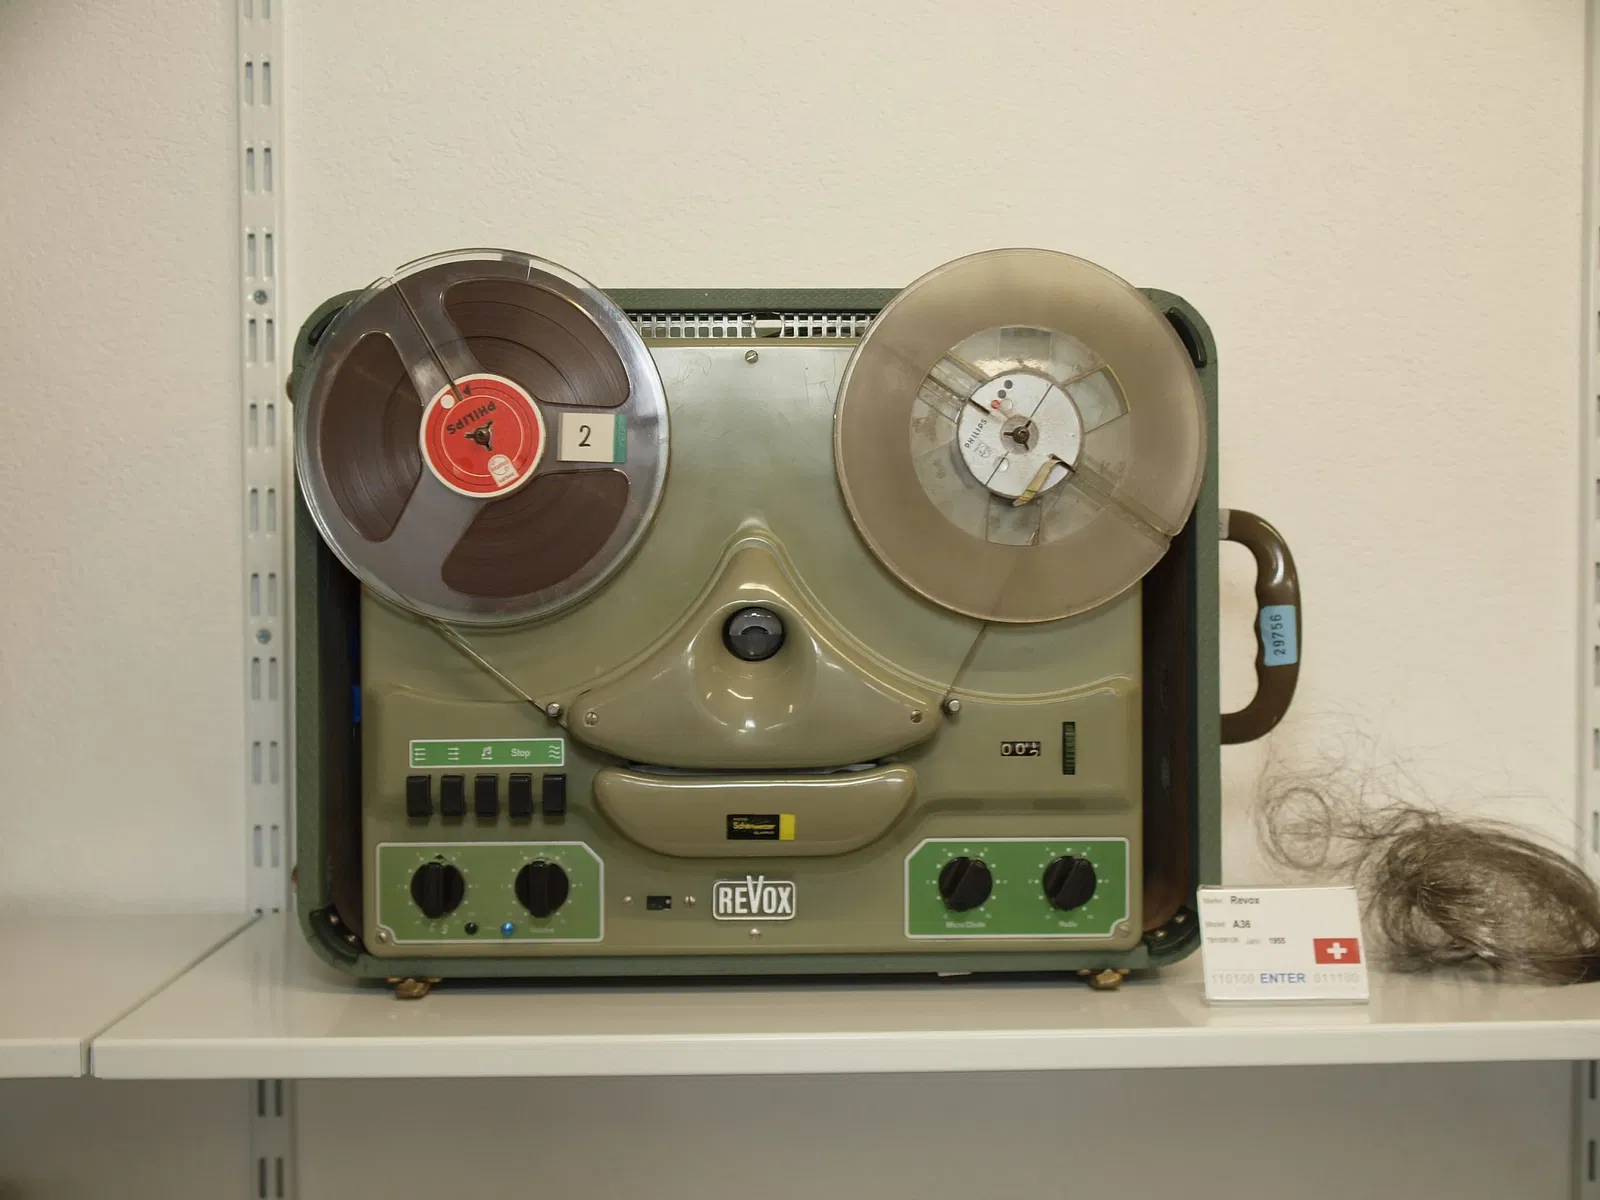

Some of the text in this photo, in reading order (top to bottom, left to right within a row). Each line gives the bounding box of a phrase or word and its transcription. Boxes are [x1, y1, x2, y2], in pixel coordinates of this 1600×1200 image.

[446, 401, 498, 435] PHILIPS
[578, 424, 592, 447] 2
[964, 418, 988, 449] PHILIPS
[1270, 614, 1287, 656] 29756
[511, 748, 531, 759] Stop
[718, 875, 792, 914] REVOX
[1230, 896, 1260, 905] Revox
[1233, 920, 1251, 929] A36
[1260, 973, 1306, 984] ENTER
